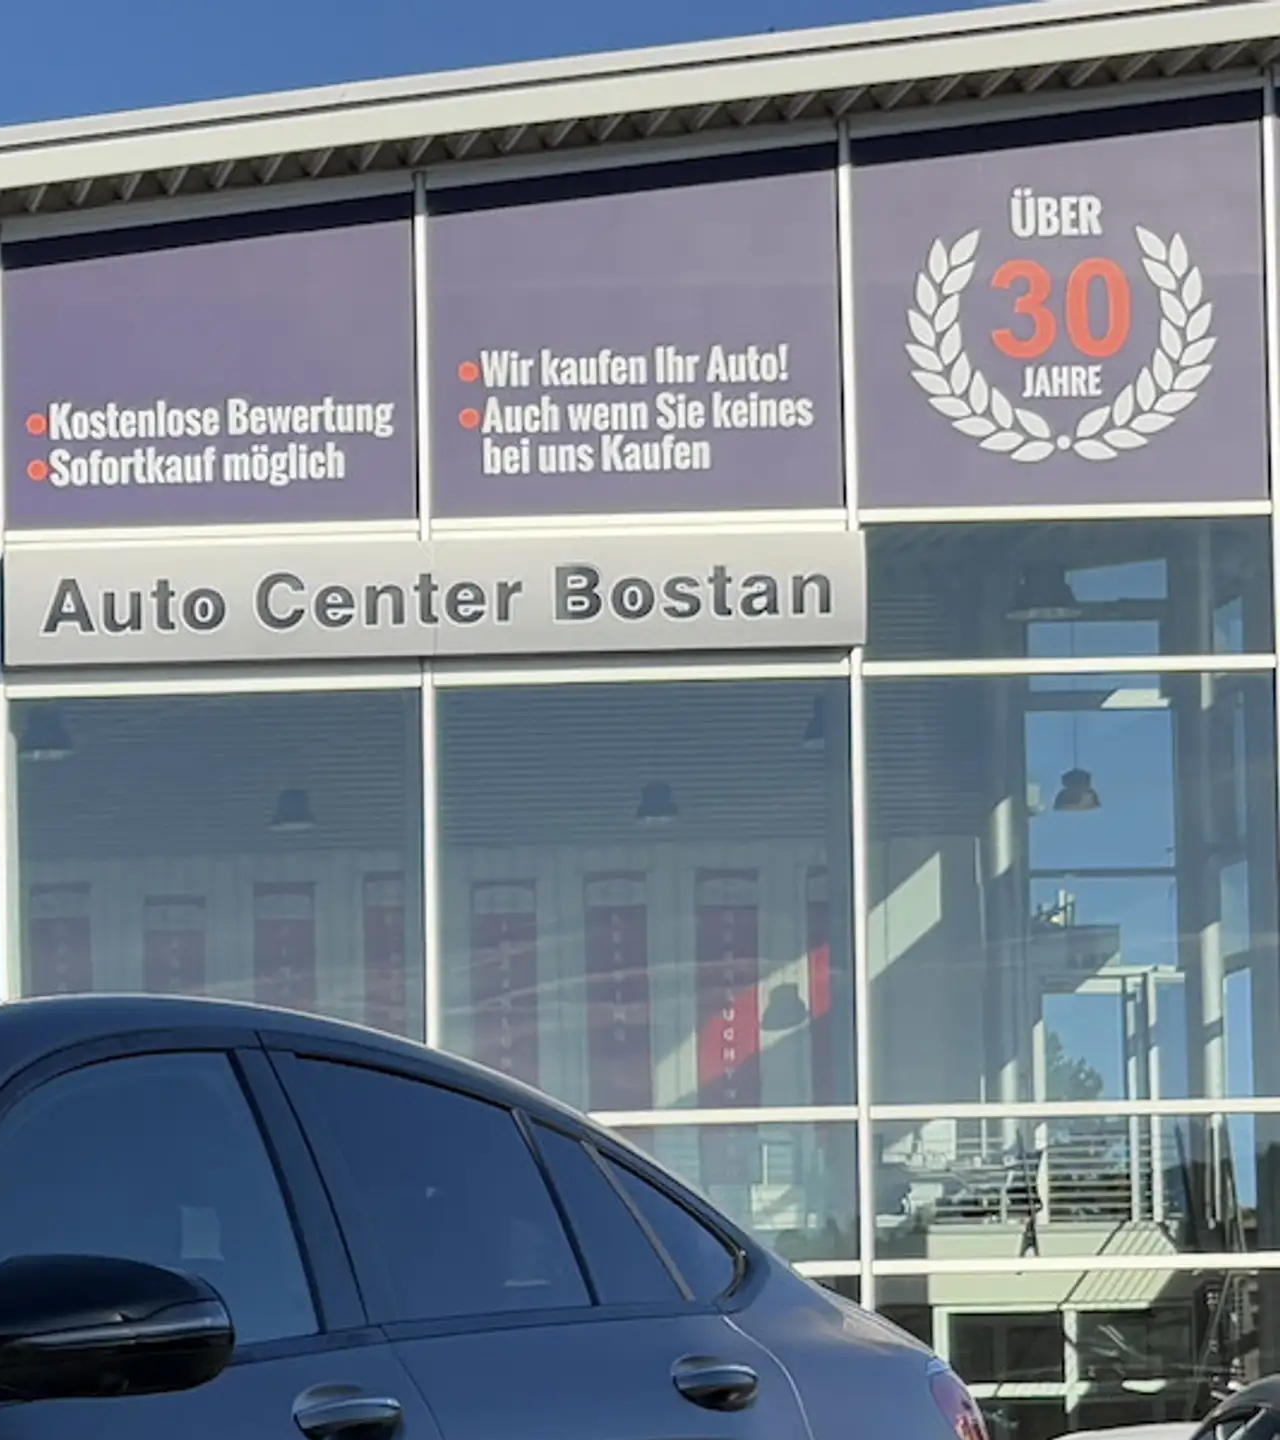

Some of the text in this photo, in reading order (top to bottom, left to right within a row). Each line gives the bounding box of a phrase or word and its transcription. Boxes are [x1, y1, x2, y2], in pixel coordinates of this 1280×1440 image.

[1011, 187, 1103, 238] ÜBER
[991, 257, 1131, 358] 30
[480, 344, 790, 388] Wir kaufen Ihr Auto!
[1022, 364, 1103, 398] JAHRE
[49, 396, 394, 441] Kostenlose Bewertung
[481, 391, 814, 434] Auch wenn Sie keines
[48, 442, 346, 487] Sofortkauf möglich
[483, 434, 711, 475] bei uns Kaufen
[41, 563, 834, 635] Auto Center Bostan
